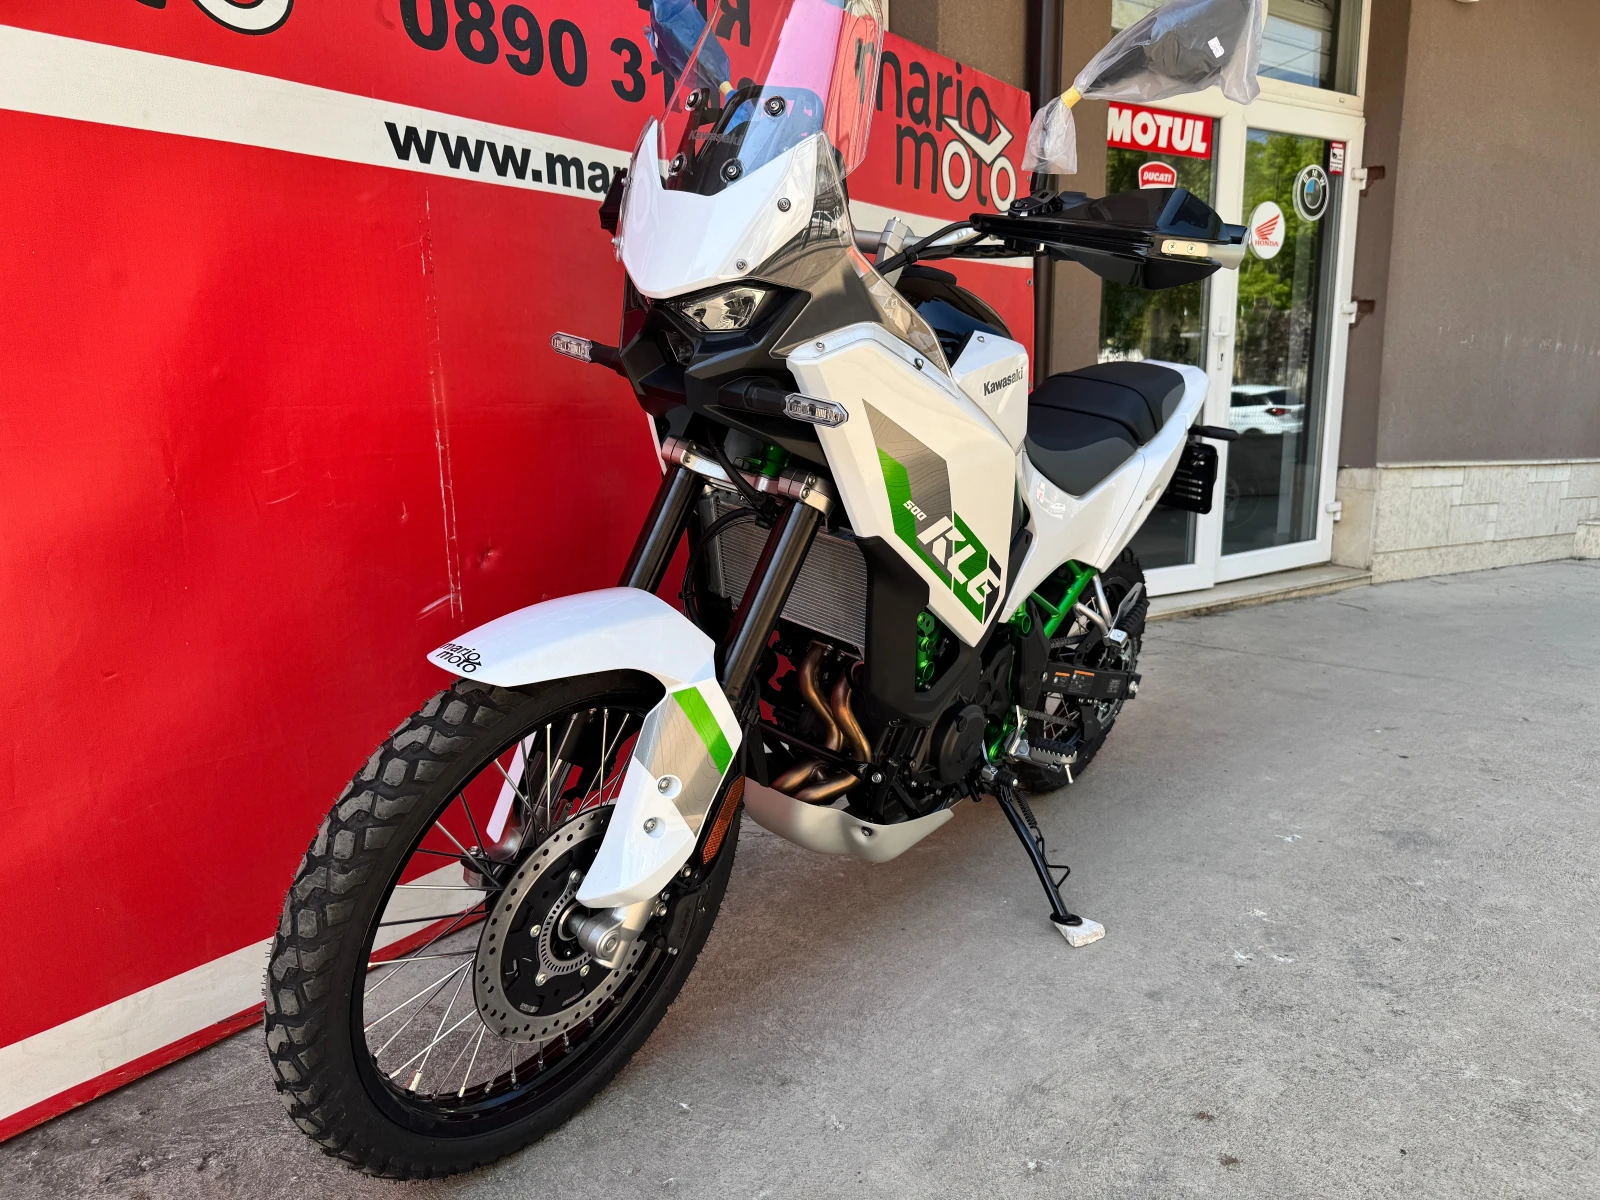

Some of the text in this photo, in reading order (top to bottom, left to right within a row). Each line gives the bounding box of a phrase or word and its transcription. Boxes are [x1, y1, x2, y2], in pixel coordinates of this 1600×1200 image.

[400, 0, 588, 87] 0890
[688, 129, 743, 147] Kawasaki
[1107, 107, 1208, 154] MOTUL
[896, 124, 1017, 212] moto
[1143, 170, 1173, 183] DUCATI
[1302, 168, 1327, 187] BMW
[1254, 239, 1280, 248] HONDA
[983, 366, 1024, 397] Kawasaki
[902, 499, 928, 521] 500
[916, 515, 1001, 606] KLE
[435, 650, 478, 673] moto
[440, 642, 481, 662] mario
